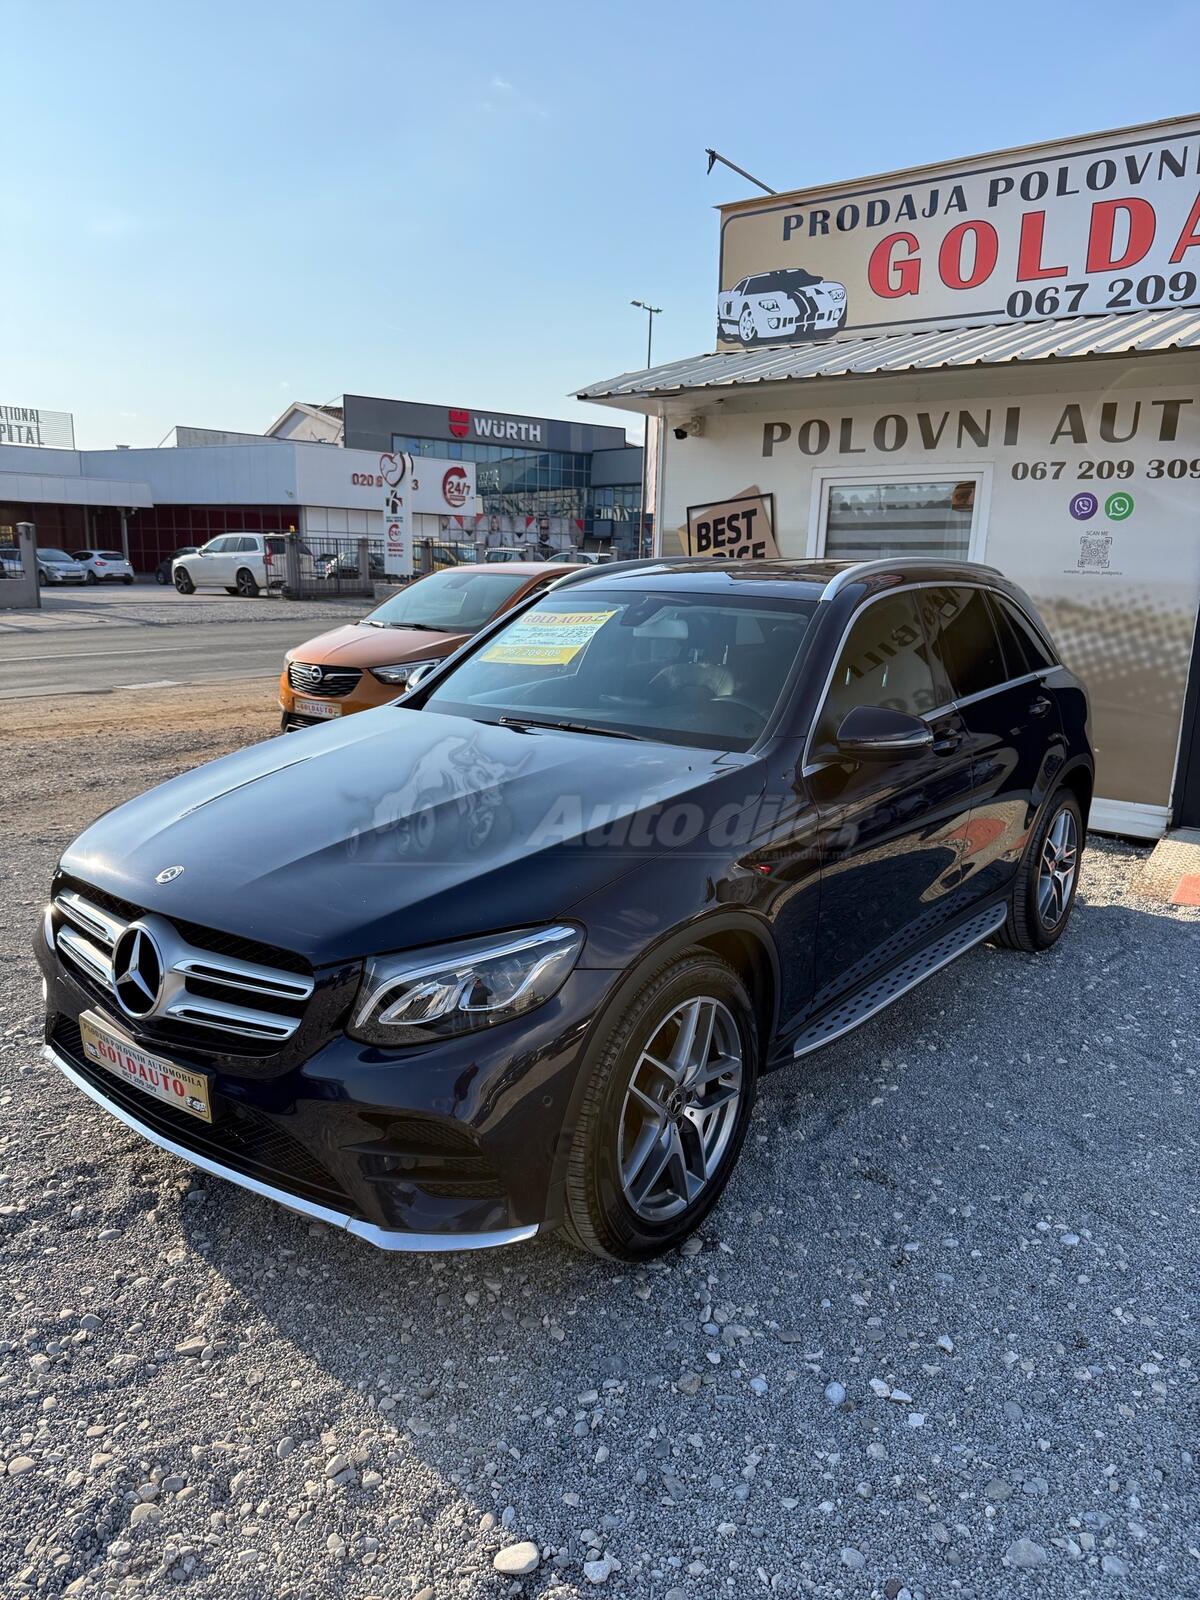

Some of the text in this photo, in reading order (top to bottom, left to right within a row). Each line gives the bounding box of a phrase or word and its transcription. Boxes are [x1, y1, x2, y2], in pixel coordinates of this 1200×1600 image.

[783, 142, 1200, 241] PRODAJA POLOVN
[1006, 271, 1198, 318] 067 209
[473, 417, 541, 442] WÜRTH
[762, 399, 1194, 457] POLOVNI AUT
[1011, 458, 1200, 480] 067 209 309
[447, 481, 471, 495] 24/7
[697, 508, 757, 552] BEST
[523, 614, 592, 624] GOLD AUTO
[98, 1040, 185, 1097] GOLDAUTO
[147, 1060, 202, 1088] AUTOMOBILA
